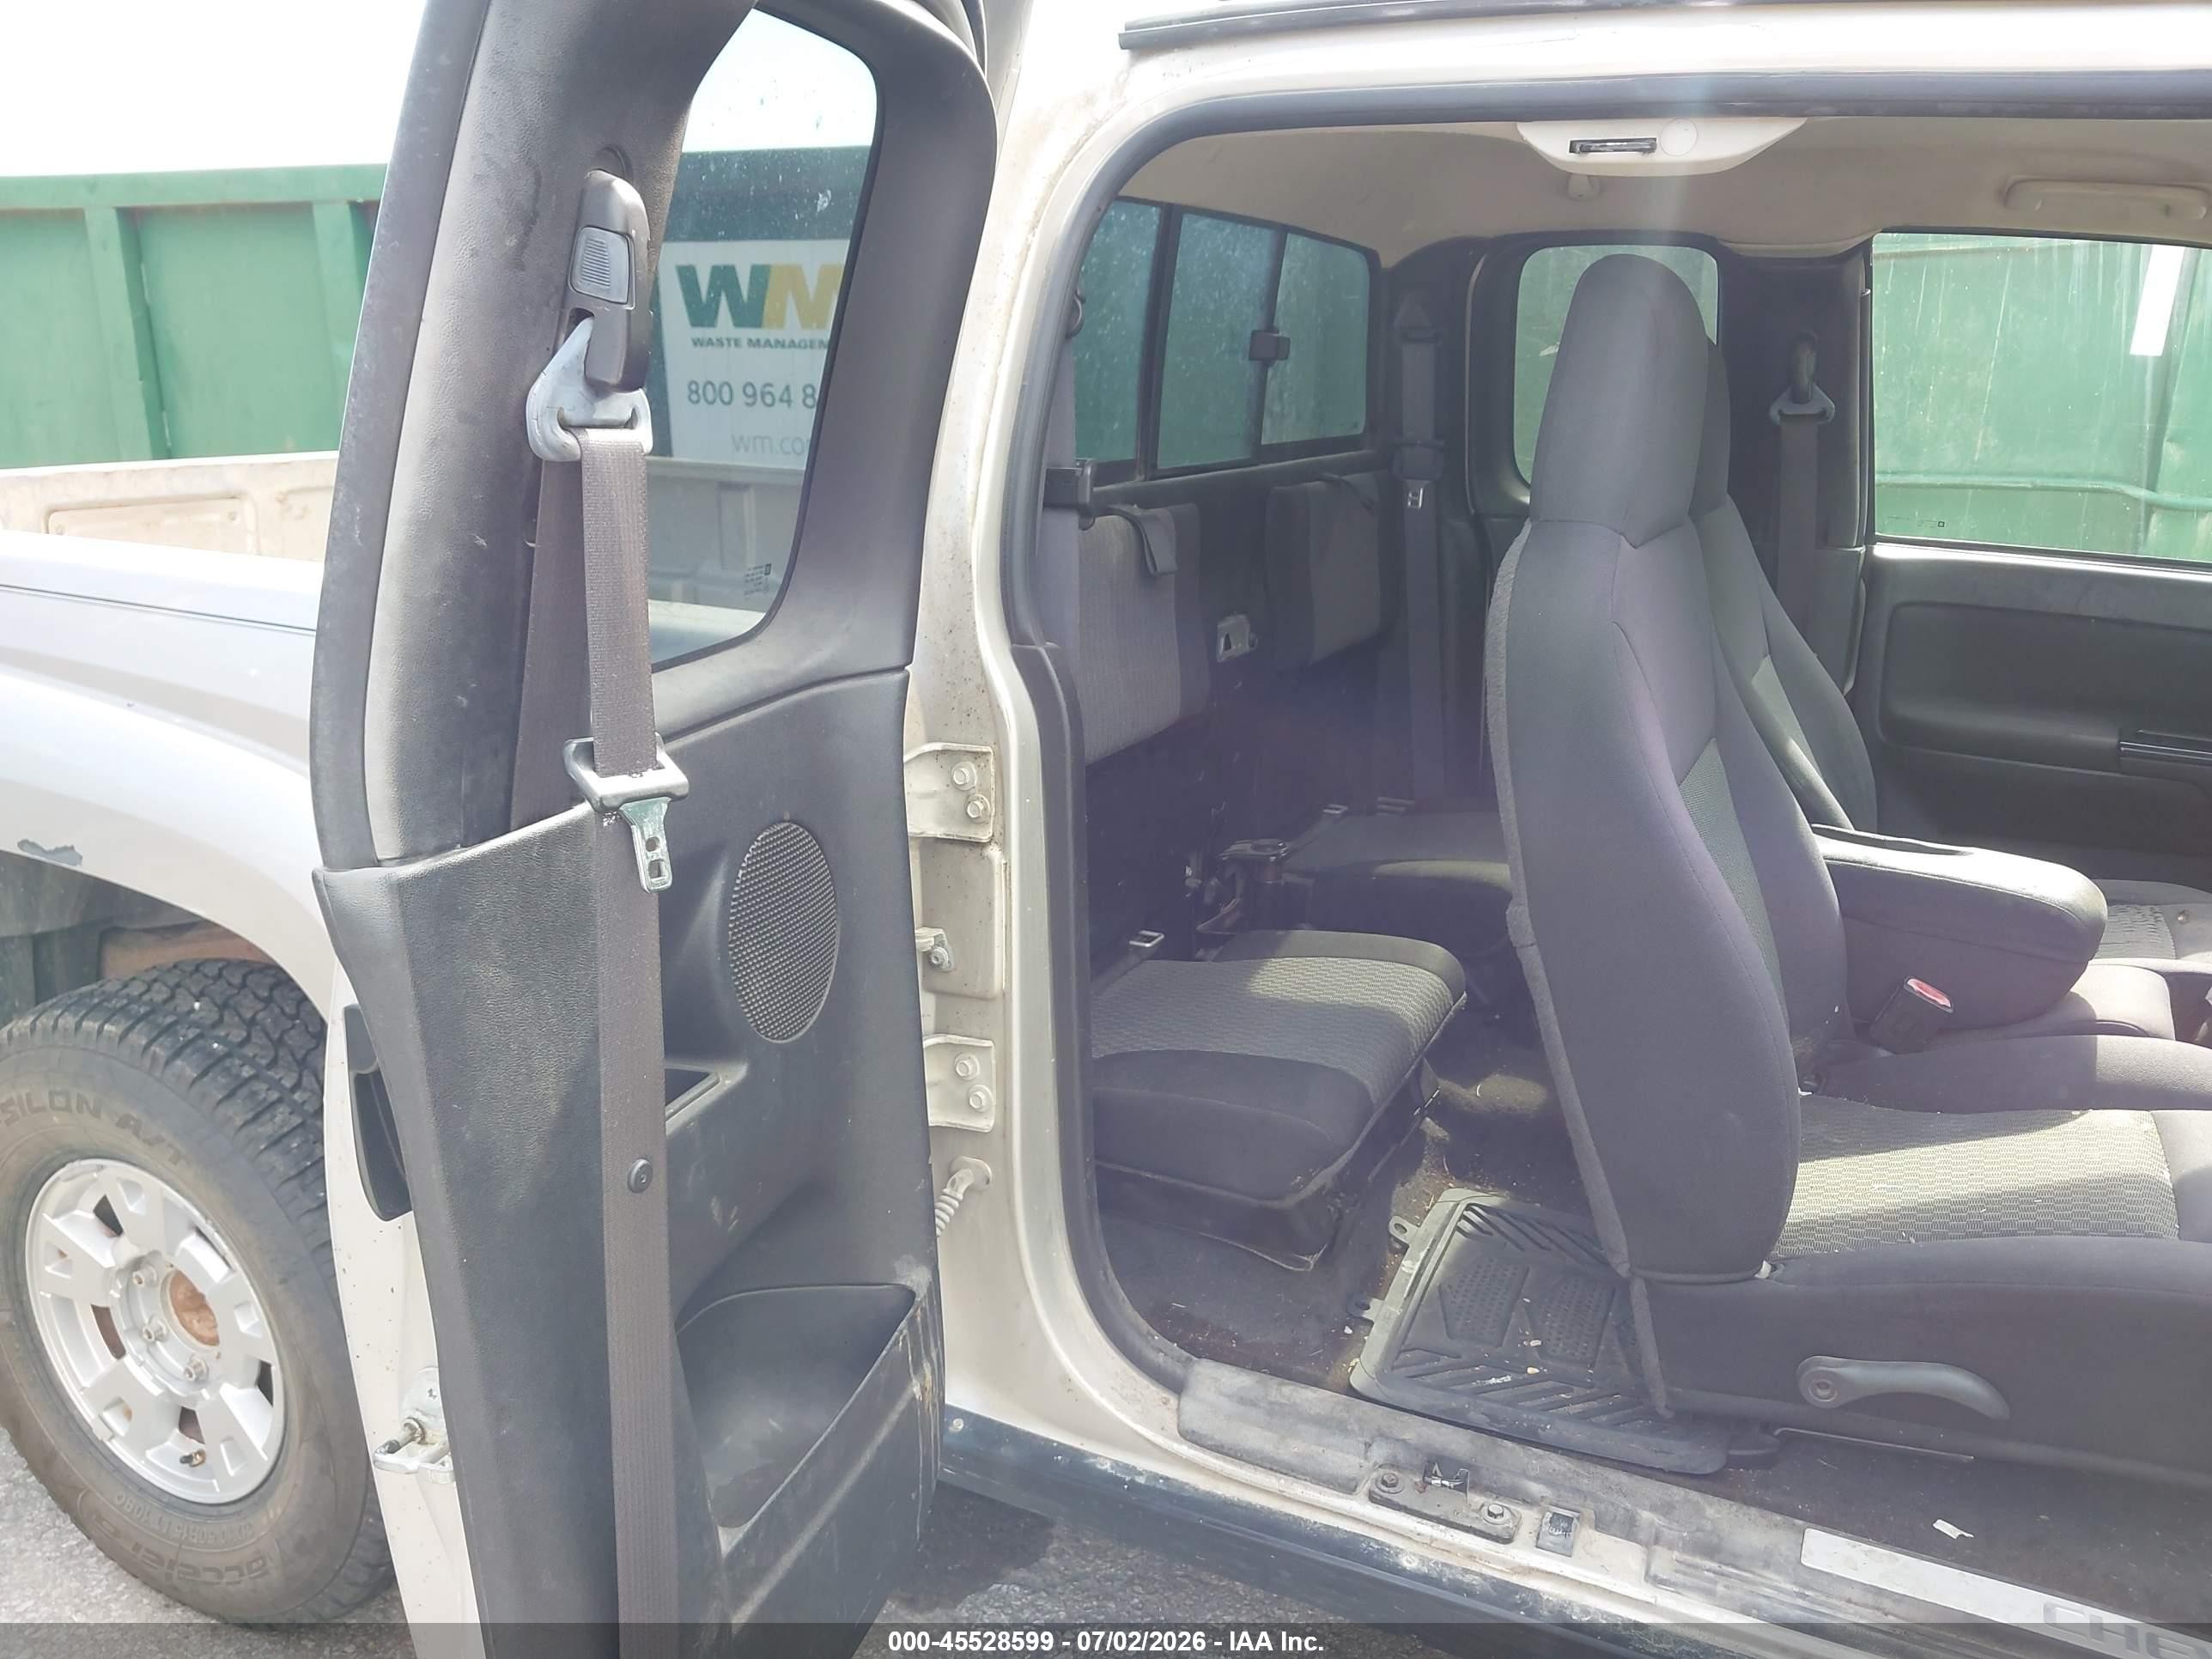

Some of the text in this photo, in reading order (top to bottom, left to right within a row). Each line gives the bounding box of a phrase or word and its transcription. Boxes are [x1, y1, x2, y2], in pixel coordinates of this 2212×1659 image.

[675, 264, 846, 330] WM
[690, 336, 743, 349] WASTE
[687, 380, 817, 410] 800 964 8
[731, 434, 810, 456] wm.co
